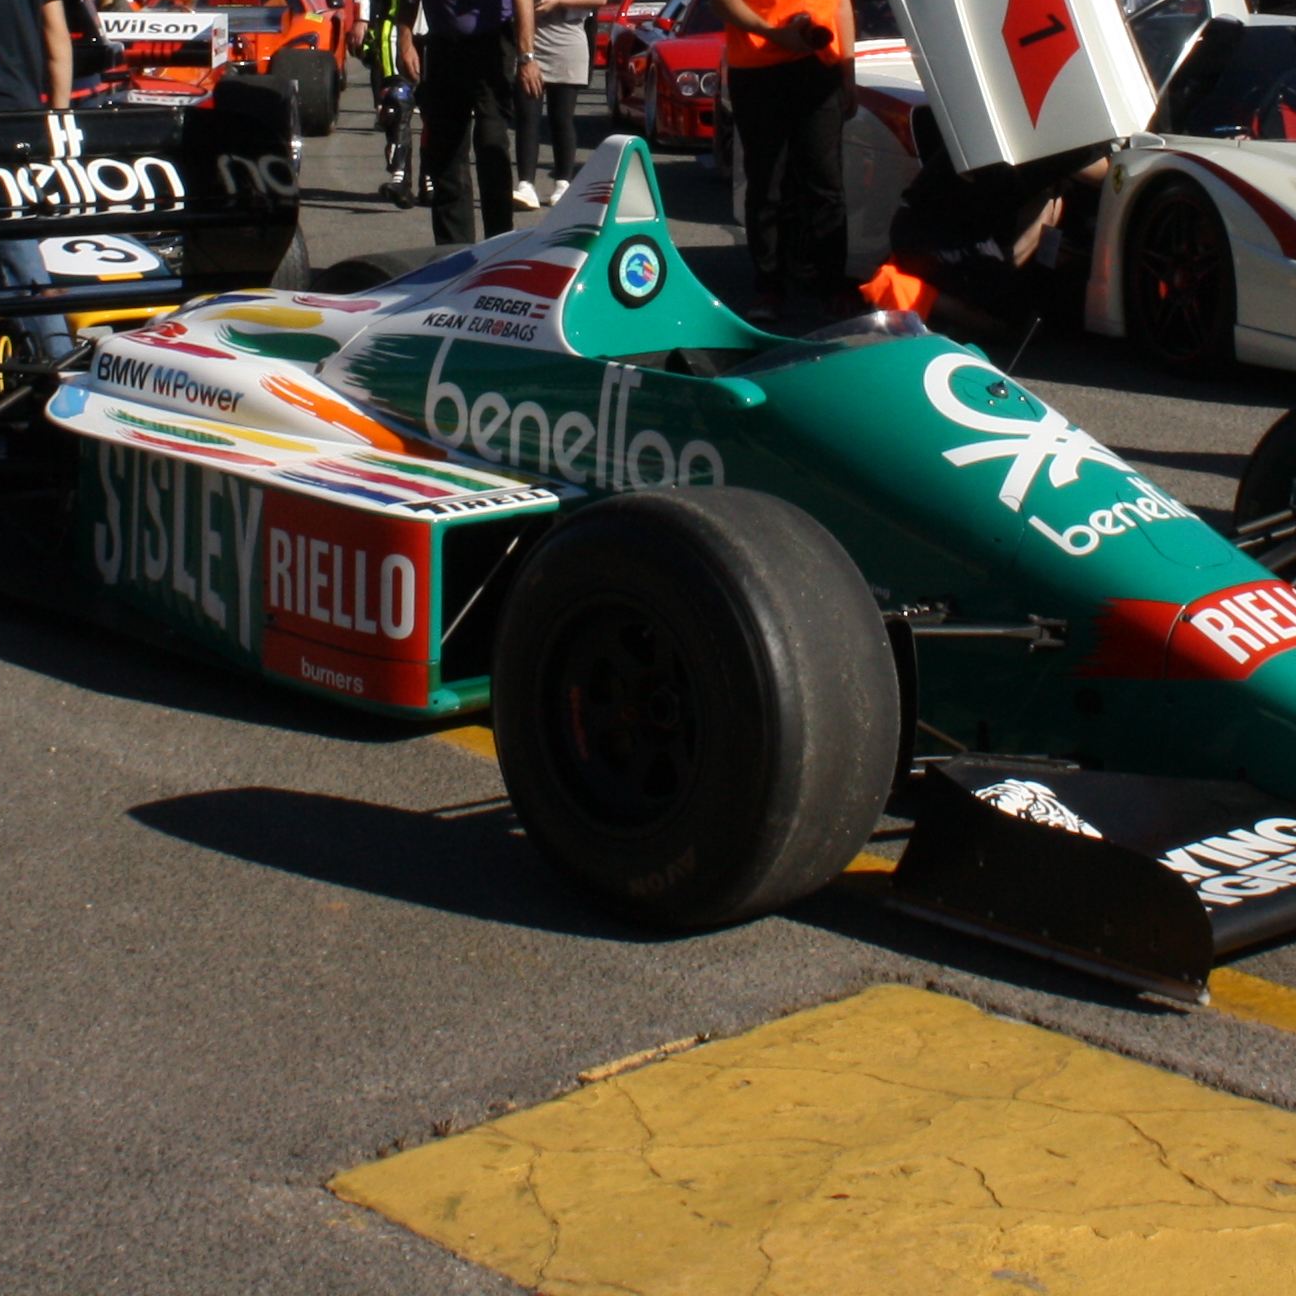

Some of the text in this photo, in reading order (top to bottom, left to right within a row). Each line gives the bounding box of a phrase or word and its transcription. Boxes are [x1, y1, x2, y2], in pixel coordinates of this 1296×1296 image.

[104, 19, 198, 34] Wilson
[1019, 13, 1066, 48] 1
[62, 239, 140, 264] 3
[423, 312, 467, 330] KEAN
[473, 295, 532, 317] BERGER
[98, 353, 153, 391] BMW
[425, 331, 725, 494] benetton
[94, 441, 263, 652] SISLEY
[269, 527, 416, 641] RIELLO
[301, 655, 365, 694] burners
